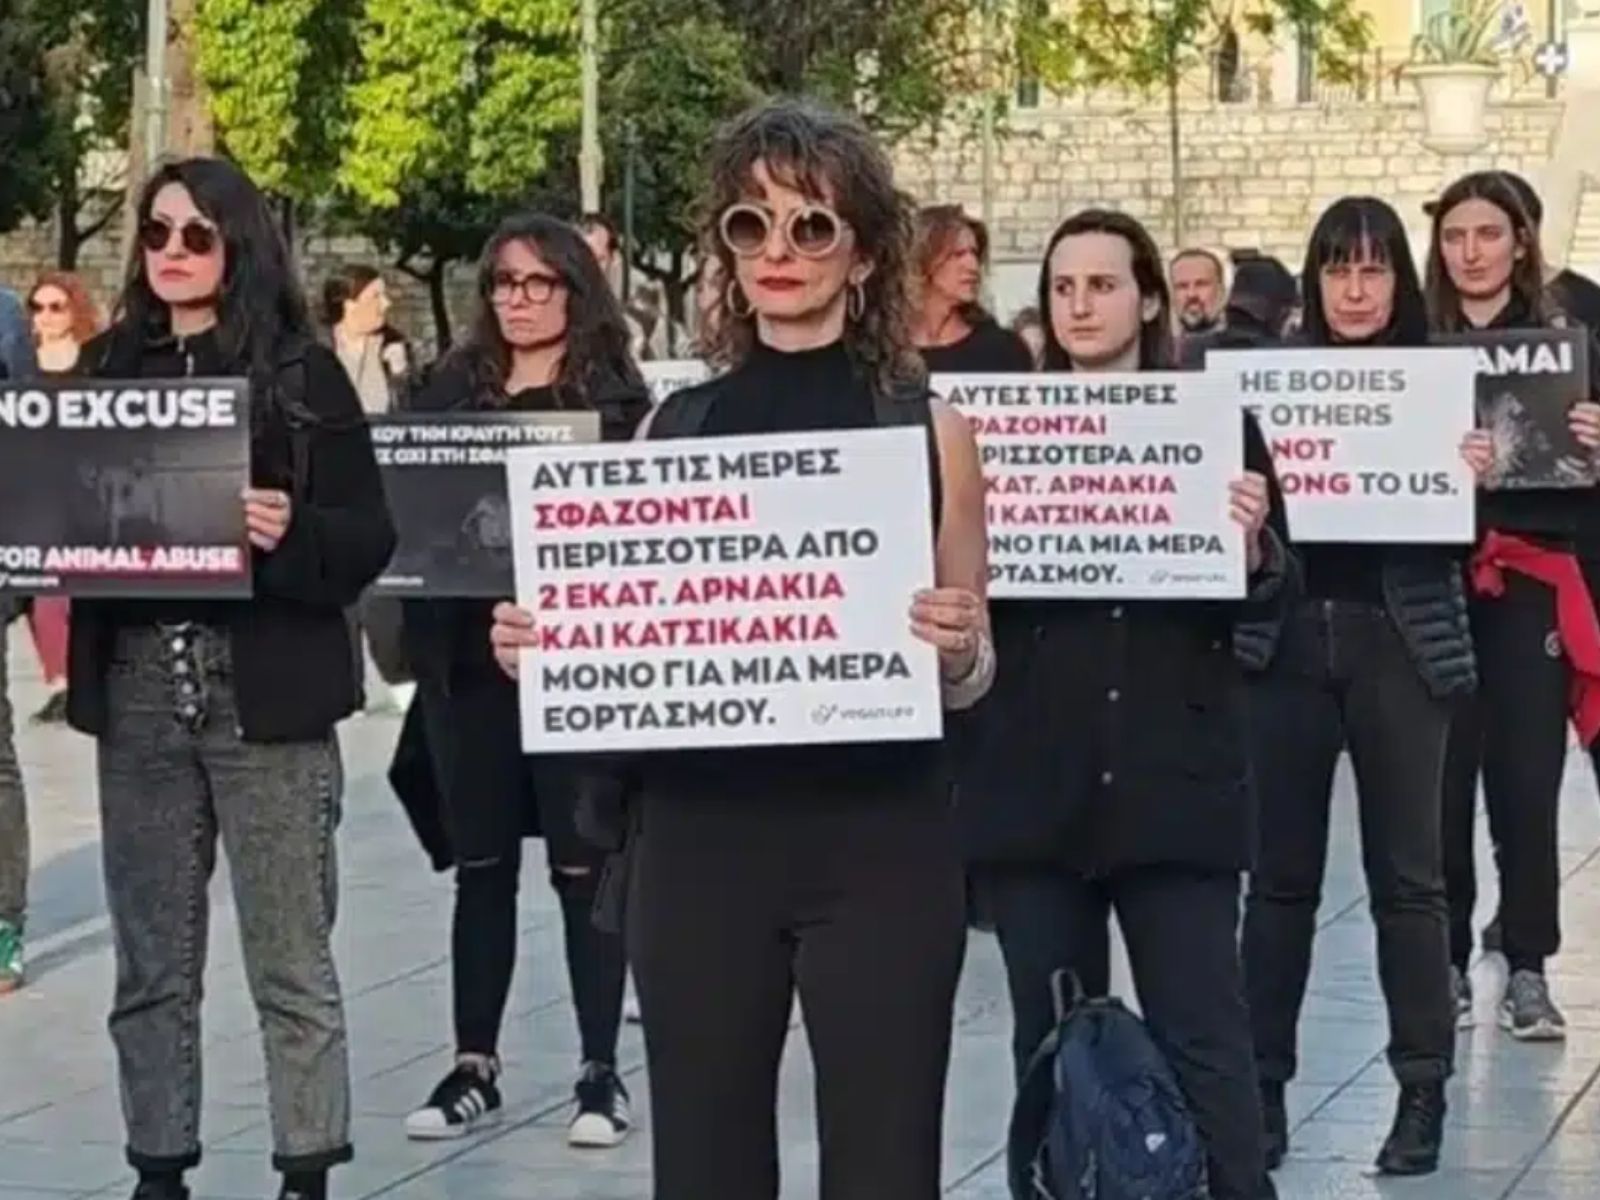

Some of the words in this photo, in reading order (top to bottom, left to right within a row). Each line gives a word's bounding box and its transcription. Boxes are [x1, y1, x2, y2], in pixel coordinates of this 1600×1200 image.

[1475, 343, 1572, 375] ΑΜΑΙ
[1241, 371, 1280, 391] HE
[1288, 370, 1405, 392] BODIES
[948, 386, 1031, 405] ΑΥΤΕΣ
[1037, 386, 1079, 405] ΤΙΣ
[1085, 385, 1177, 404] ΜΕΡΕΣ
[58, 389, 236, 428] EXCUSE
[1271, 404, 1391, 426] OTHERS
[372, 425, 407, 441] ΚΟΥ
[969, 416, 1106, 434] ΦΑΖΟΝΤΑΙ
[982, 445, 1135, 465] ΡΙΣΣΟΤΕΡΑ
[1141, 444, 1203, 464] ΑΠΟ
[1271, 439, 1334, 460] NOT
[533, 459, 647, 490] ΑΥΤΕΣ
[649, 455, 711, 485] ΤΙΣ
[719, 449, 841, 479] ΜΕΡΕΣ
[984, 475, 1041, 494] ΚΑΤ.
[1050, 474, 1176, 494] ΑΡΝΑΚΙΑ
[1280, 473, 1350, 494] ONG
[1358, 473, 1402, 494] TO
[1409, 473, 1458, 494] US.
[535, 494, 749, 530] ΣΦΑΖΟΝΤΑΙ
[1002, 504, 1171, 524] ΚΑΤΣΙΚΑΚΙΑ
[537, 535, 787, 569] ΠΕΡΙΣΣΟΤΕΡΑ
[798, 529, 878, 558] ΑΠΟ
[988, 535, 1033, 554] ΝΟ
[1040, 535, 1085, 554] ΓΙΑ
[1091, 535, 1141, 554] ΜΙΑ
[1148, 535, 1224, 554] ΜΕΡΑ
[44, 547, 147, 570] ANIMAL
[151, 547, 239, 570] ABUSE
[987, 564, 1123, 583] ΡΤΑΣΜΟΥ.
[540, 585, 558, 610] 2
[567, 581, 665, 609] ΕΚΑΤ.
[674, 573, 844, 604] ΑΡΝΑΚΙΑ
[541, 624, 603, 651] ΚΑΙ
[613, 614, 838, 647] ΚΑΤΣΙΚΑΚΙΑ
[543, 661, 655, 691] ΜΟΝΟ
[664, 660, 723, 687] ΓΙΑ
[733, 657, 799, 684] ΜΙΑ
[809, 652, 910, 681] ΜΕΡΑ
[545, 699, 775, 732] ΕΟΡΤΑΣΜΟΥ.
